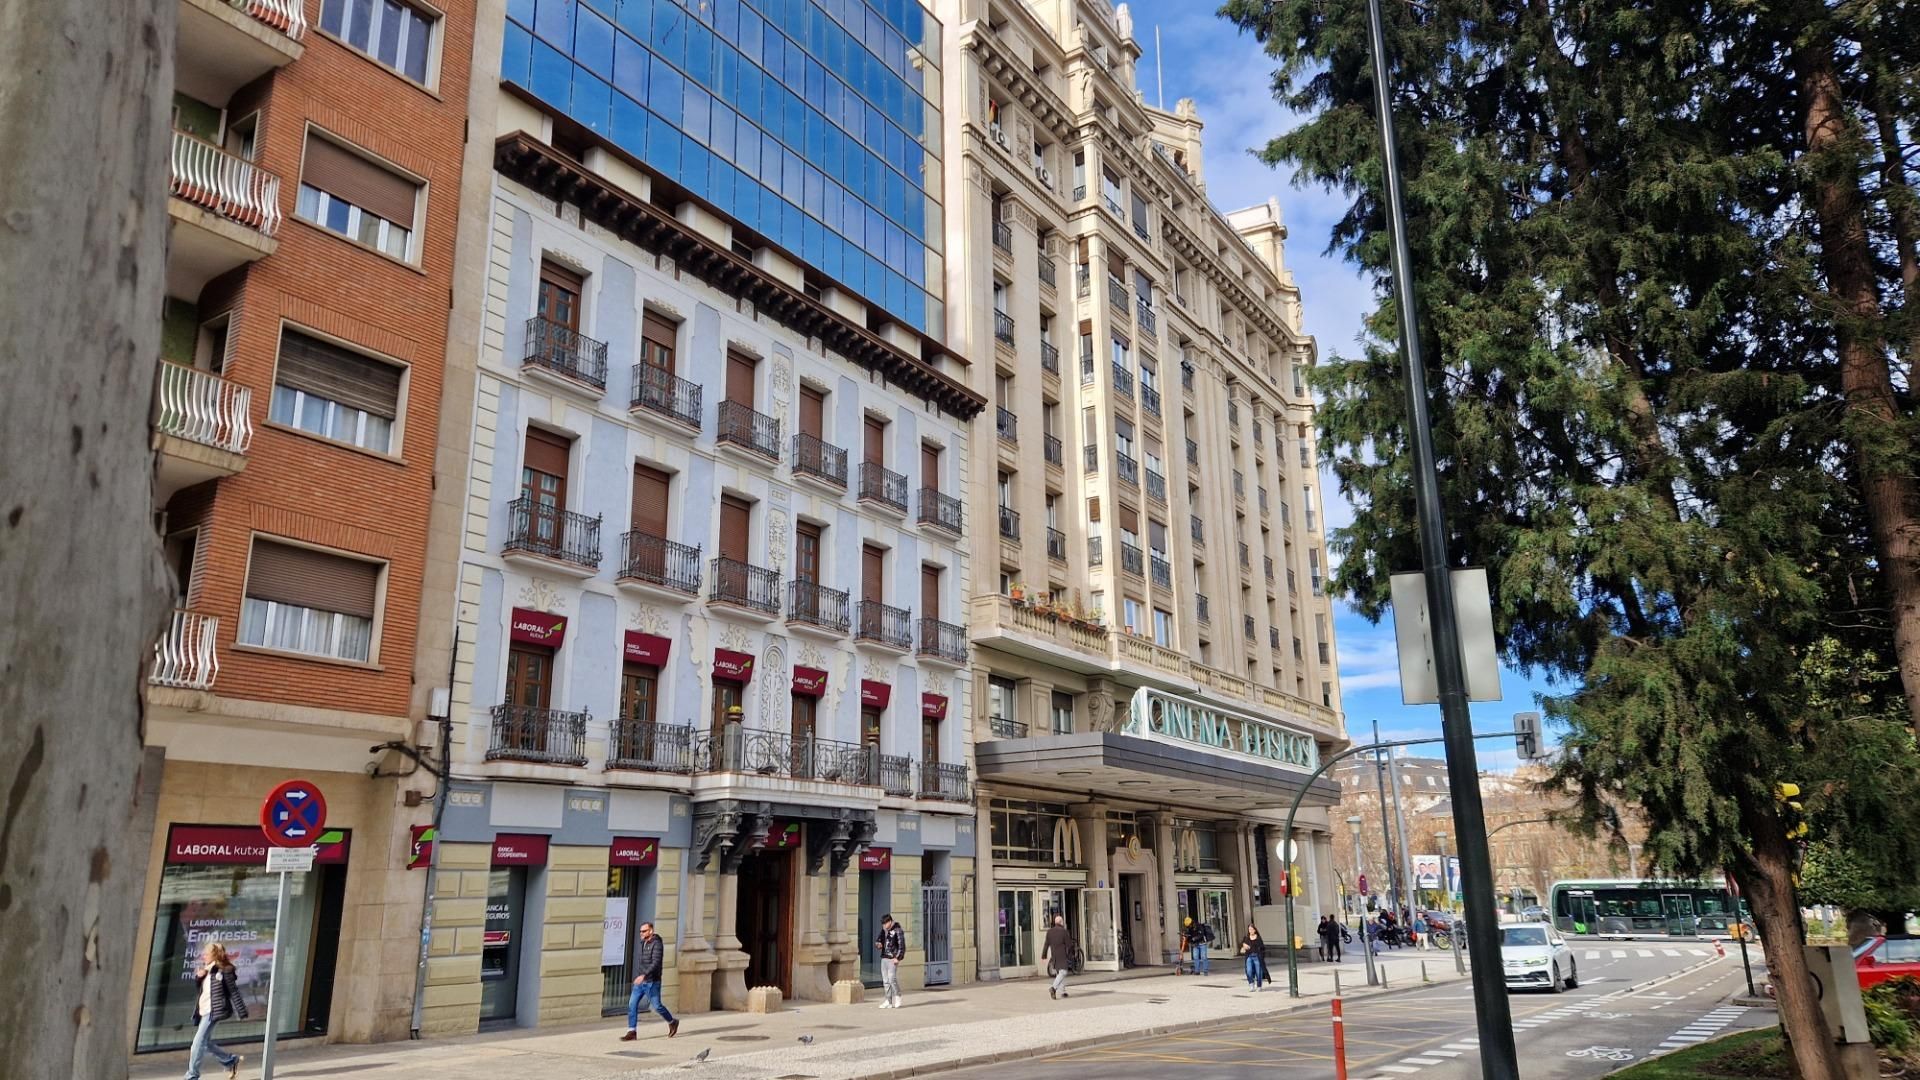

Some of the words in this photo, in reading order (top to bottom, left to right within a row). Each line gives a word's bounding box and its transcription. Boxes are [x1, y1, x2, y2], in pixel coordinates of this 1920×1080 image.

[513, 621, 545, 634] LABORAL
[715, 660, 738, 671] LABORAL
[1150, 695, 1234, 750] CINEMA
[1241, 722, 1313, 767] ELISEOS
[176, 844, 232, 856] LABORAL
[233, 845, 265, 856] kutxa
[485, 912, 510, 920] EGUROS
[189, 919, 224, 928] LABORAL
[603, 919, 623, 929] 0/50
[187, 929, 258, 942] Empresas
